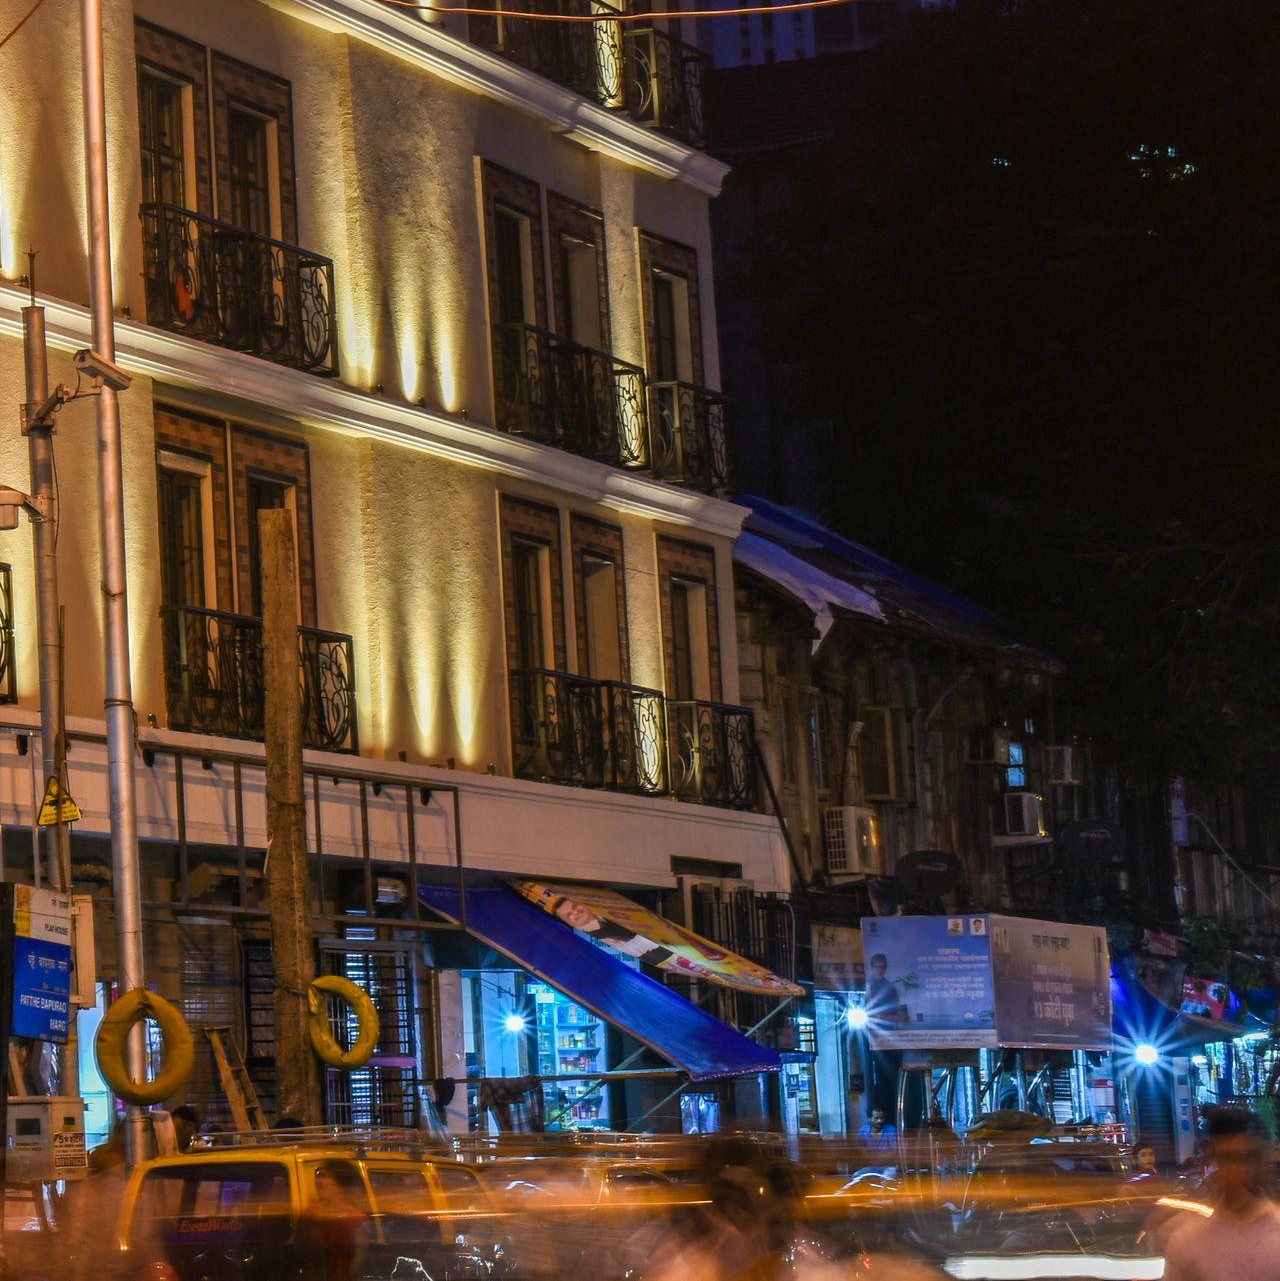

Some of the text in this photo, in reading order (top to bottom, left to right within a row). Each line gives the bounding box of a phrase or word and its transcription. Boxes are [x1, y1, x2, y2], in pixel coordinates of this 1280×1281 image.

[55, 925, 68, 936] HOUSE
[20, 993, 67, 1014] PATTHE BAPURAO
[49, 1018, 66, 1032] MARG
